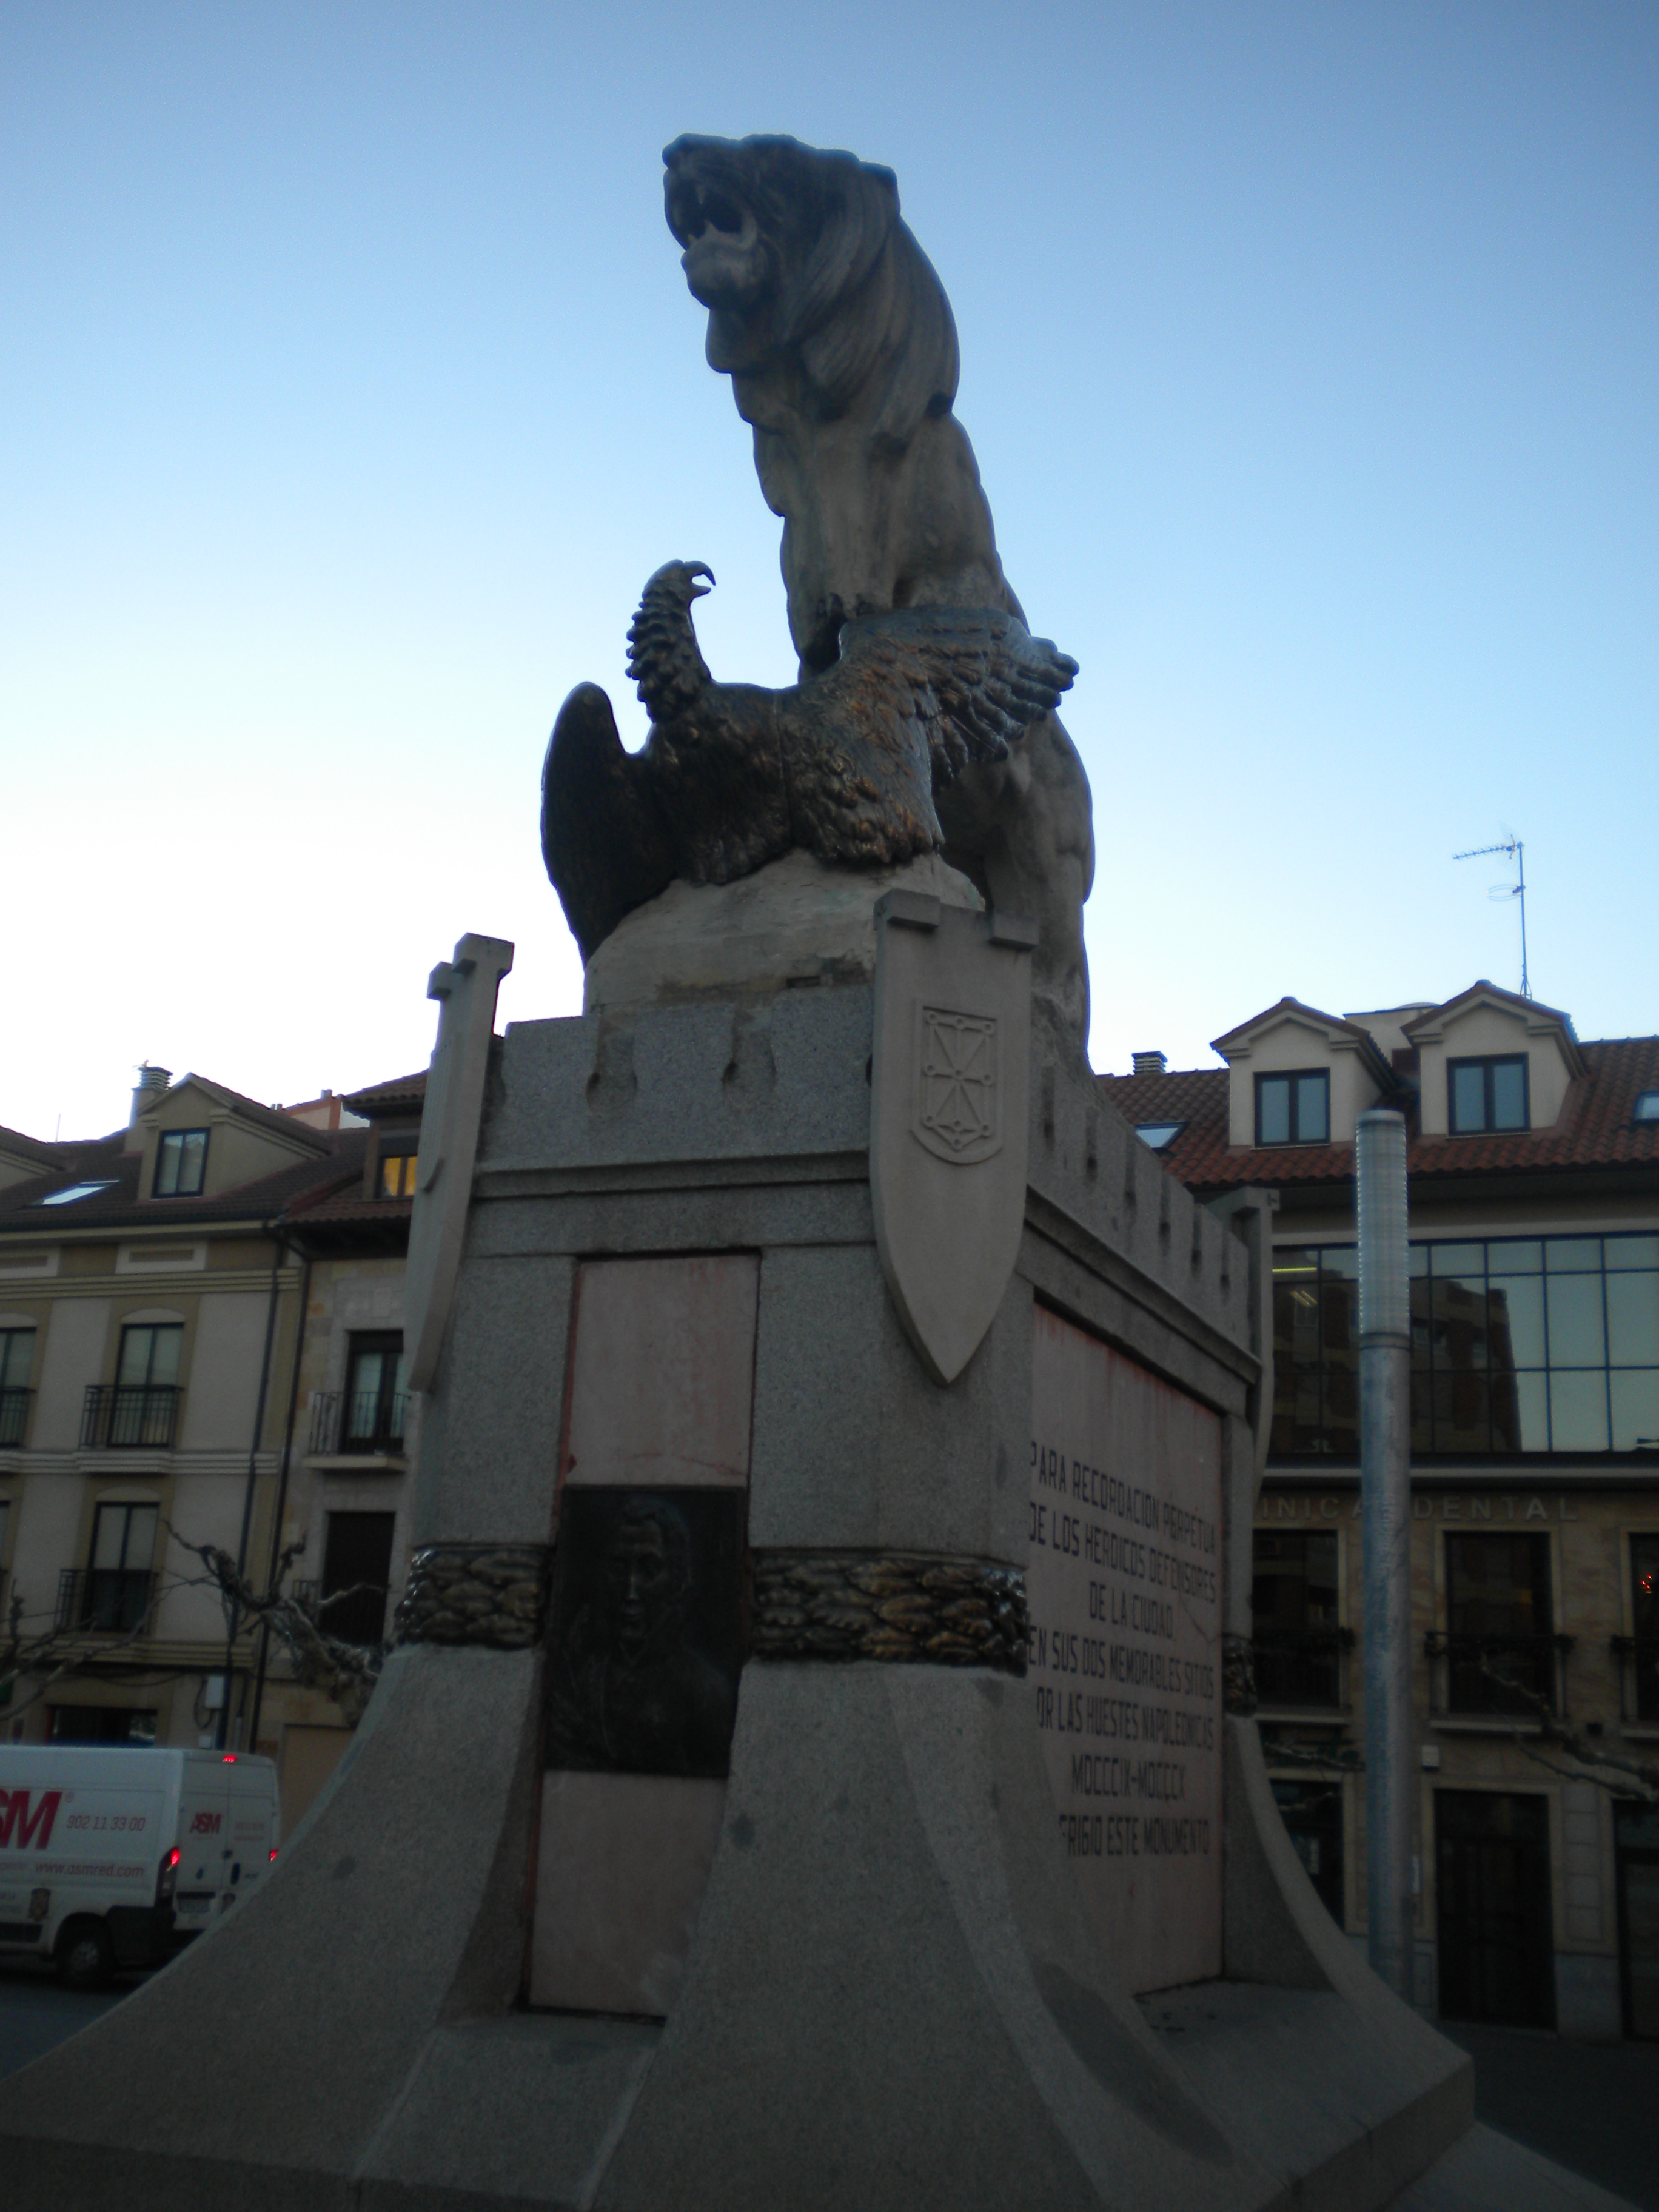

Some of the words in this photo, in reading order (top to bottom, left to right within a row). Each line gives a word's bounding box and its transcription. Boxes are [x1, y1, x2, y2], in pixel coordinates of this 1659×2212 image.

[1030, 1441, 1066, 1493] PARA
[1073, 1460, 1159, 1532] RECORDACION
[1262, 1496, 1363, 1518] INICA
[1413, 1496, 1577, 1520] DENTAL
[1053, 1510, 1080, 1557] LOS
[1085, 1523, 1145, 1579] HEROICOS
[1150, 1547, 1216, 1604] DEFENSORES
[1090, 1581, 1106, 1622] DE
[1112, 1587, 1127, 1627] LA
[1133, 1594, 1173, 1639] CIUDAD
[1029, 1625, 1047, 1667] EN
[1053, 1631, 1078, 1674] SUS
[1082, 1638, 1106, 1679] DOS
[1110, 1644, 1182, 1692] MEMORABLES
[1185, 1661, 1214, 1700] SITIOS
[1058, 1691, 1082, 1733] LAS
[1087, 1695, 1139, 1740] HUESTES
[66, 1815, 90, 1829] 902
[92, 1816, 107, 1830] 11
[110, 1816, 127, 1831] 33
[129, 1817, 146, 1831] 00
[189, 1812, 221, 1834] ASM
[1107, 1816, 1139, 1855] ESTE
[1144, 1817, 1209, 1855] MONUMENTO
[35, 1862, 144, 1878] www.asmred.com
